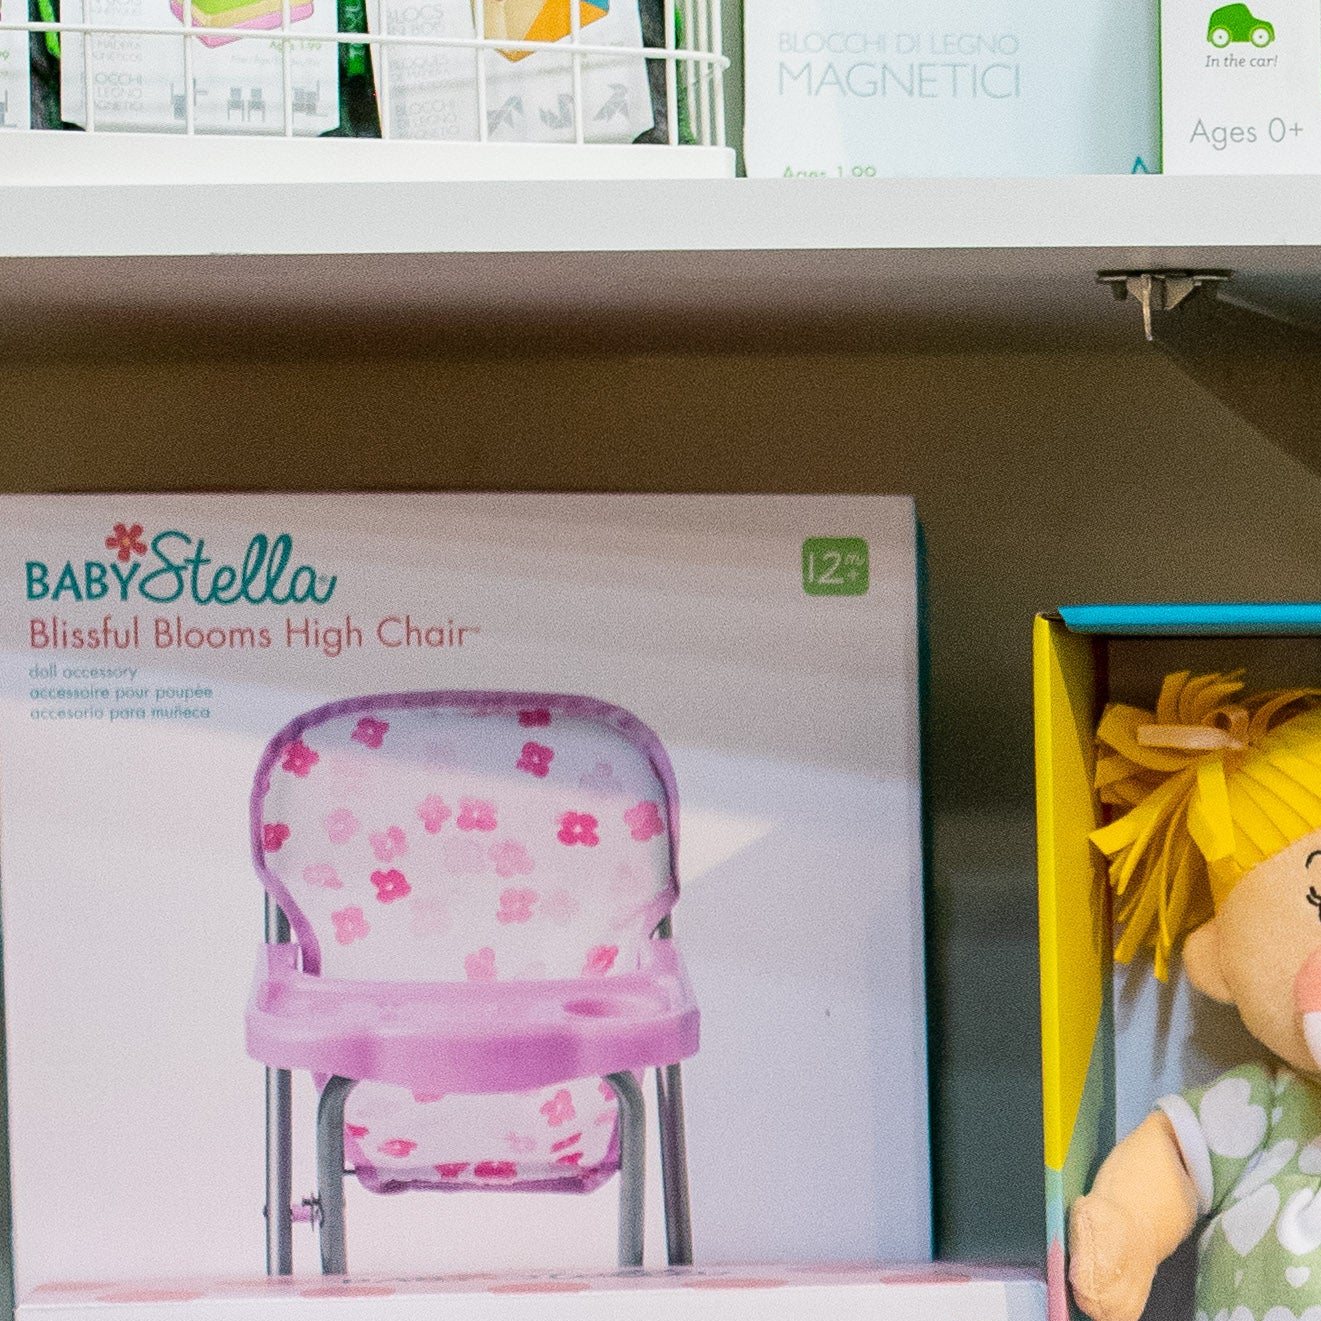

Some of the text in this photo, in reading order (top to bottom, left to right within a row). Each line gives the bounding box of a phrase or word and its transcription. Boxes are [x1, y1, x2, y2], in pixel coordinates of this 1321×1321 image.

[779, 32, 1019, 54] BLOCCHI DI LEGNO
[1205, 54, 1278, 68] In the car!
[778, 62, 1020, 99] MAGNETICI
[1190, 117, 1304, 149] Ages 0+
[30, 615, 139, 650] Blissful
[154, 616, 271, 649] Blooms
[286, 617, 362, 658] High
[29, 664, 137, 681] doll accessory
[30, 686, 109, 700] accessoire
[116, 688, 149, 702] pour
